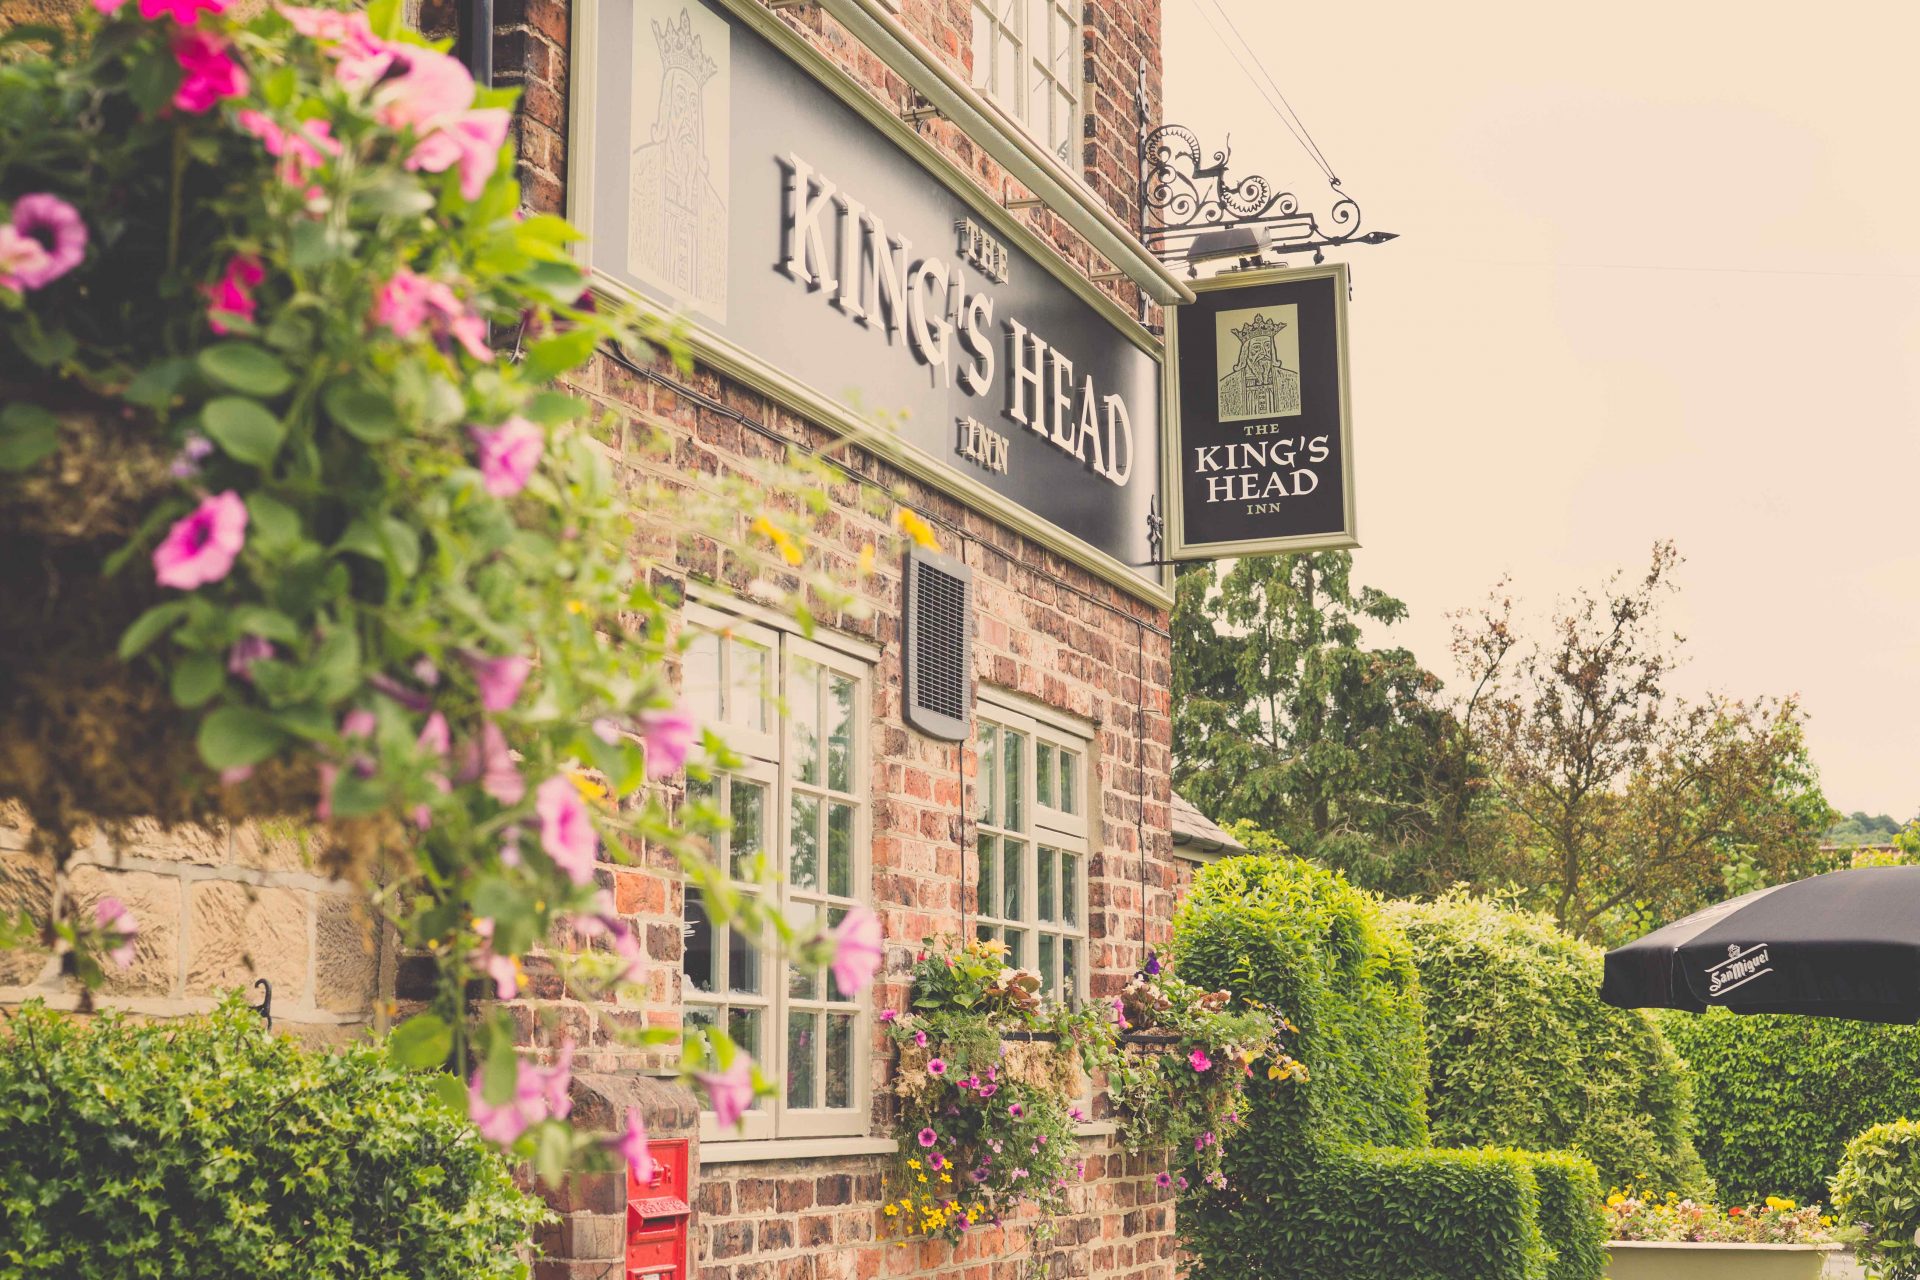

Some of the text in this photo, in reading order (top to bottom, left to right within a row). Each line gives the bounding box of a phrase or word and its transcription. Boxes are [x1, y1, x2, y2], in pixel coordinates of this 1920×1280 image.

[966, 216, 1009, 285] THE
[787, 151, 1134, 487] KING'S HEAD
[965, 416, 1009, 475] INN
[1244, 424, 1279, 436] THE
[1195, 434, 1330, 473] KING'S
[1206, 468, 1319, 503] HEAD
[1247, 503, 1281, 515] INN
